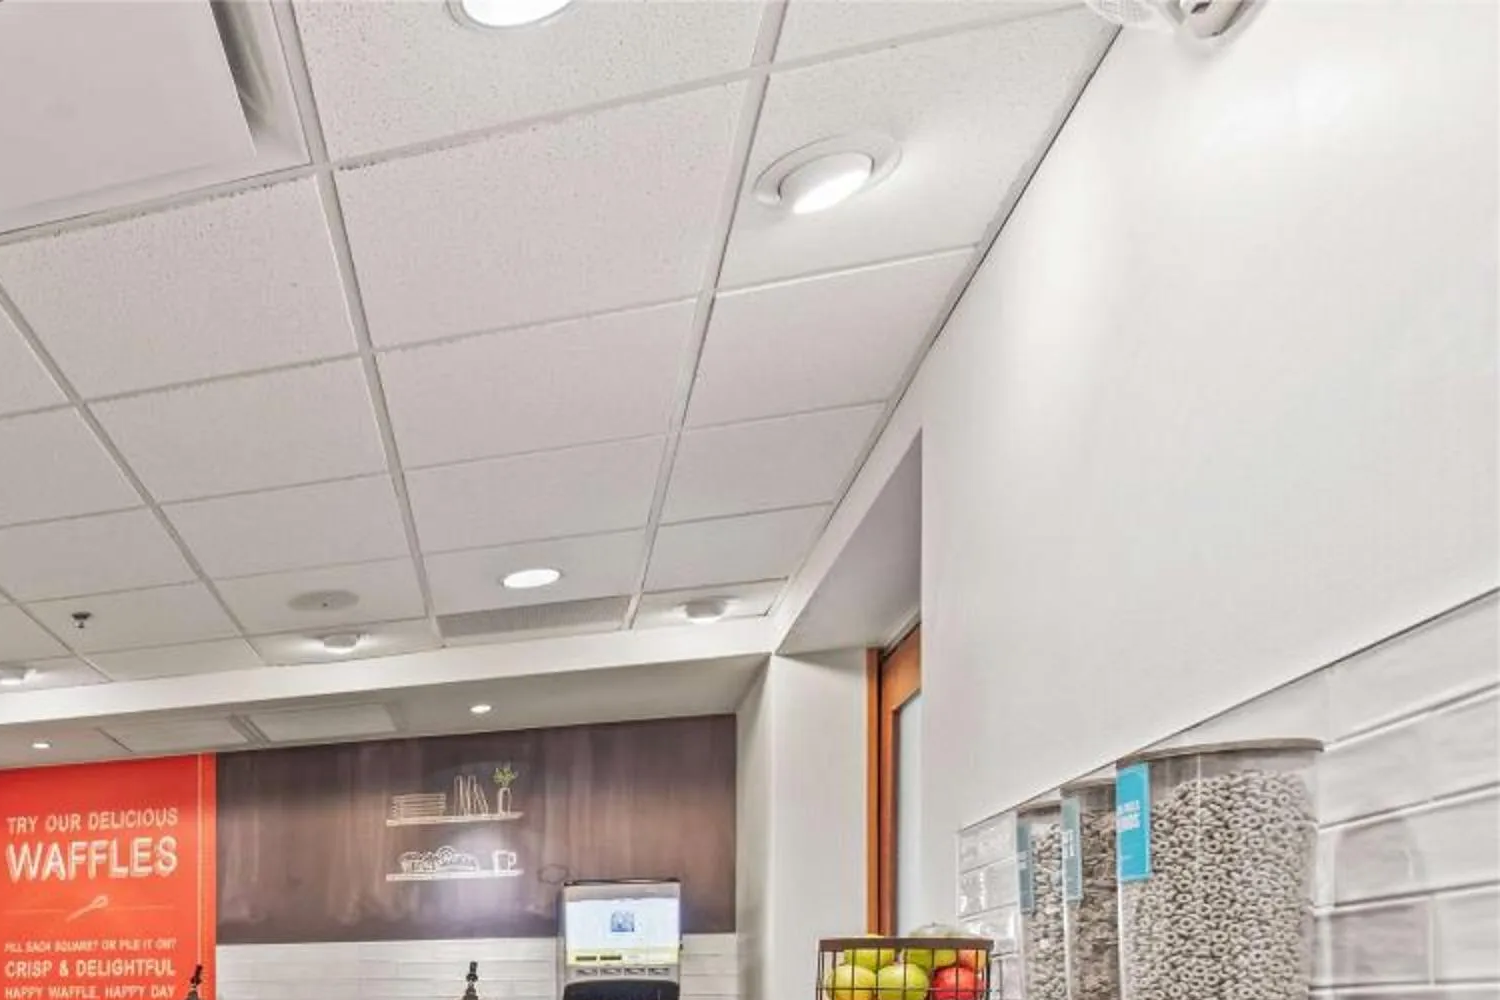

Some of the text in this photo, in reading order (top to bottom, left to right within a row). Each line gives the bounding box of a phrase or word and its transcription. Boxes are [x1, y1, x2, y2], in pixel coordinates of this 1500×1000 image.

[6, 807, 178, 835] TRY OUR DELICIOUS
[6, 835, 179, 884] WAFFLES
[4, 958, 176, 978] CRISP & DELIGHTFUL
[4, 986, 43, 1000] HAPPY
[105, 984, 145, 999] HAPPY
[150, 983, 177, 998] DAY
